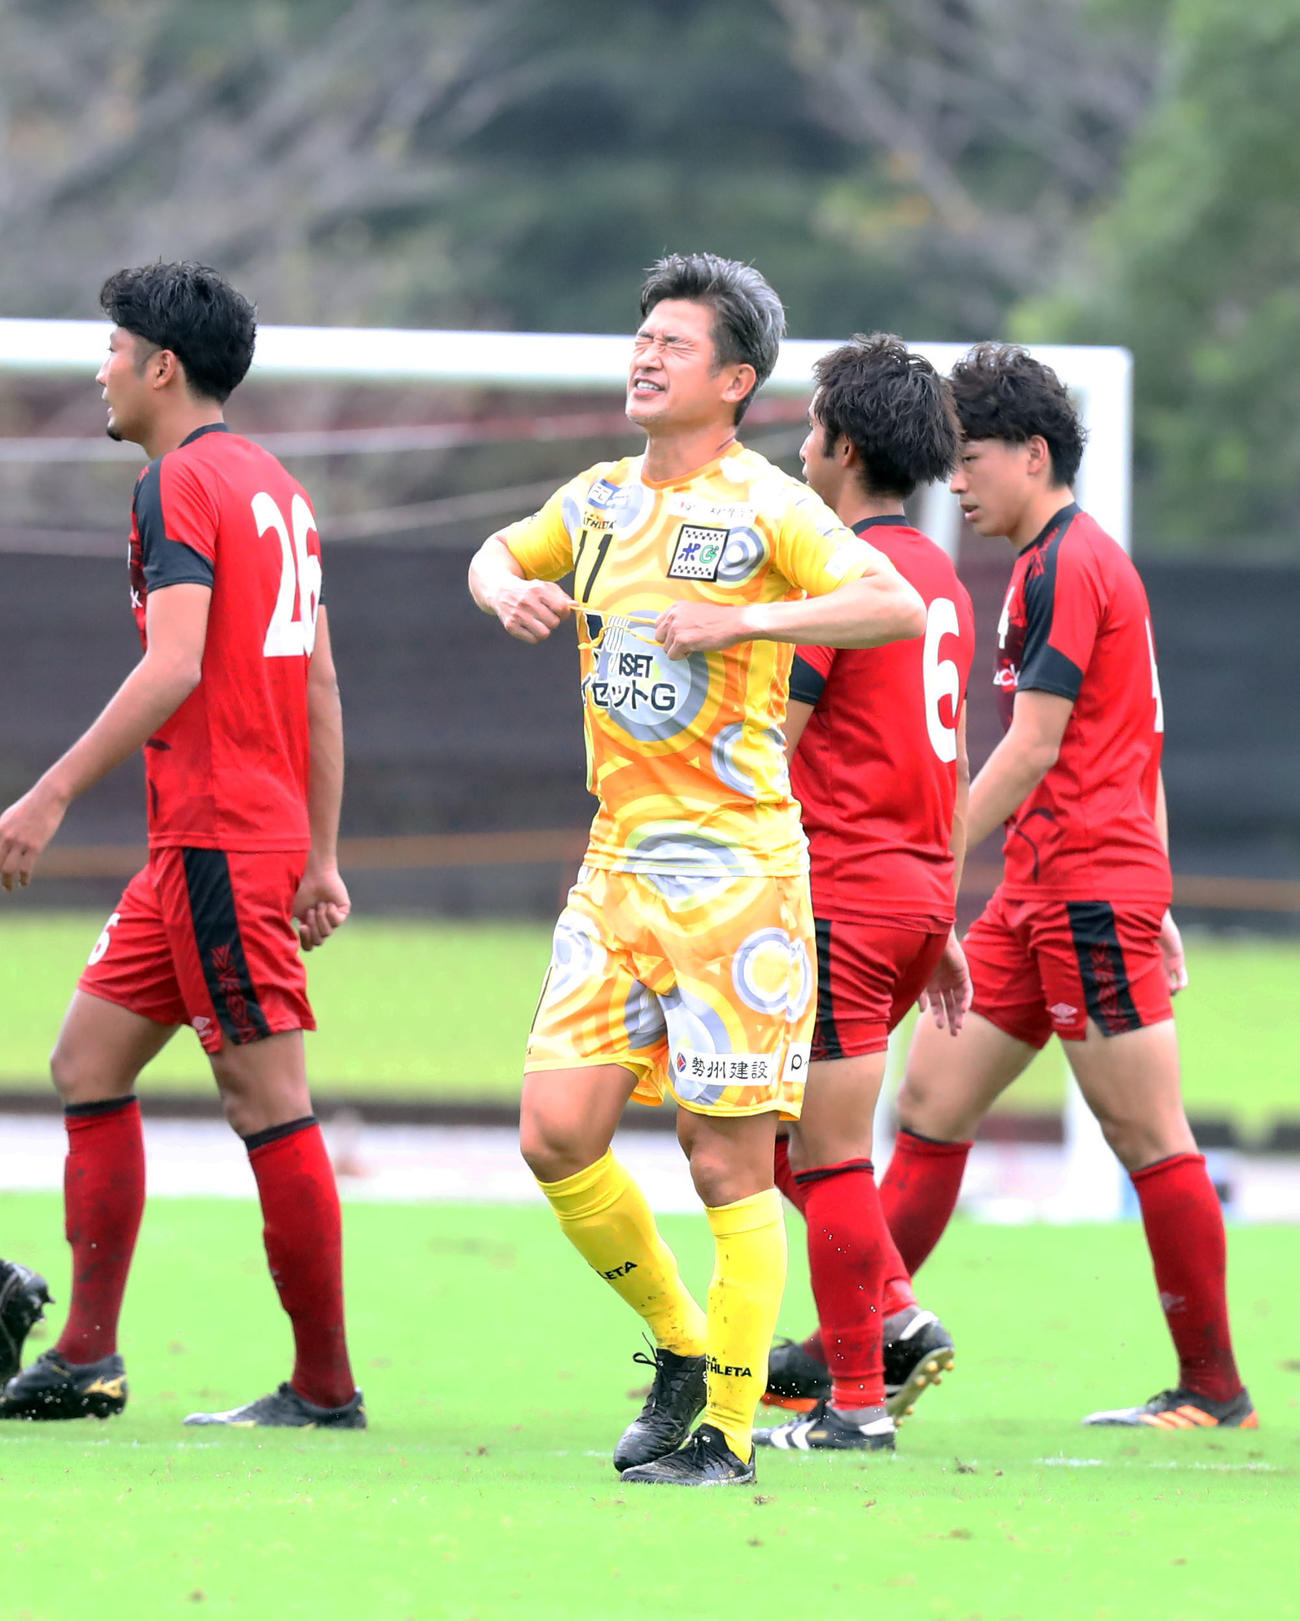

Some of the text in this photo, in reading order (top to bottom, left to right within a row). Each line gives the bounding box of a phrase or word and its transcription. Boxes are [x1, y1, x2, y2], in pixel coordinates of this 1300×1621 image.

[251, 491, 323, 658] 26
[574, 530, 613, 603] 11
[619, 652, 653, 678] ISET
[923, 597, 960, 764] 6
[87, 912, 120, 966] 6
[692, 1057, 768, 1079] 勢州建設
